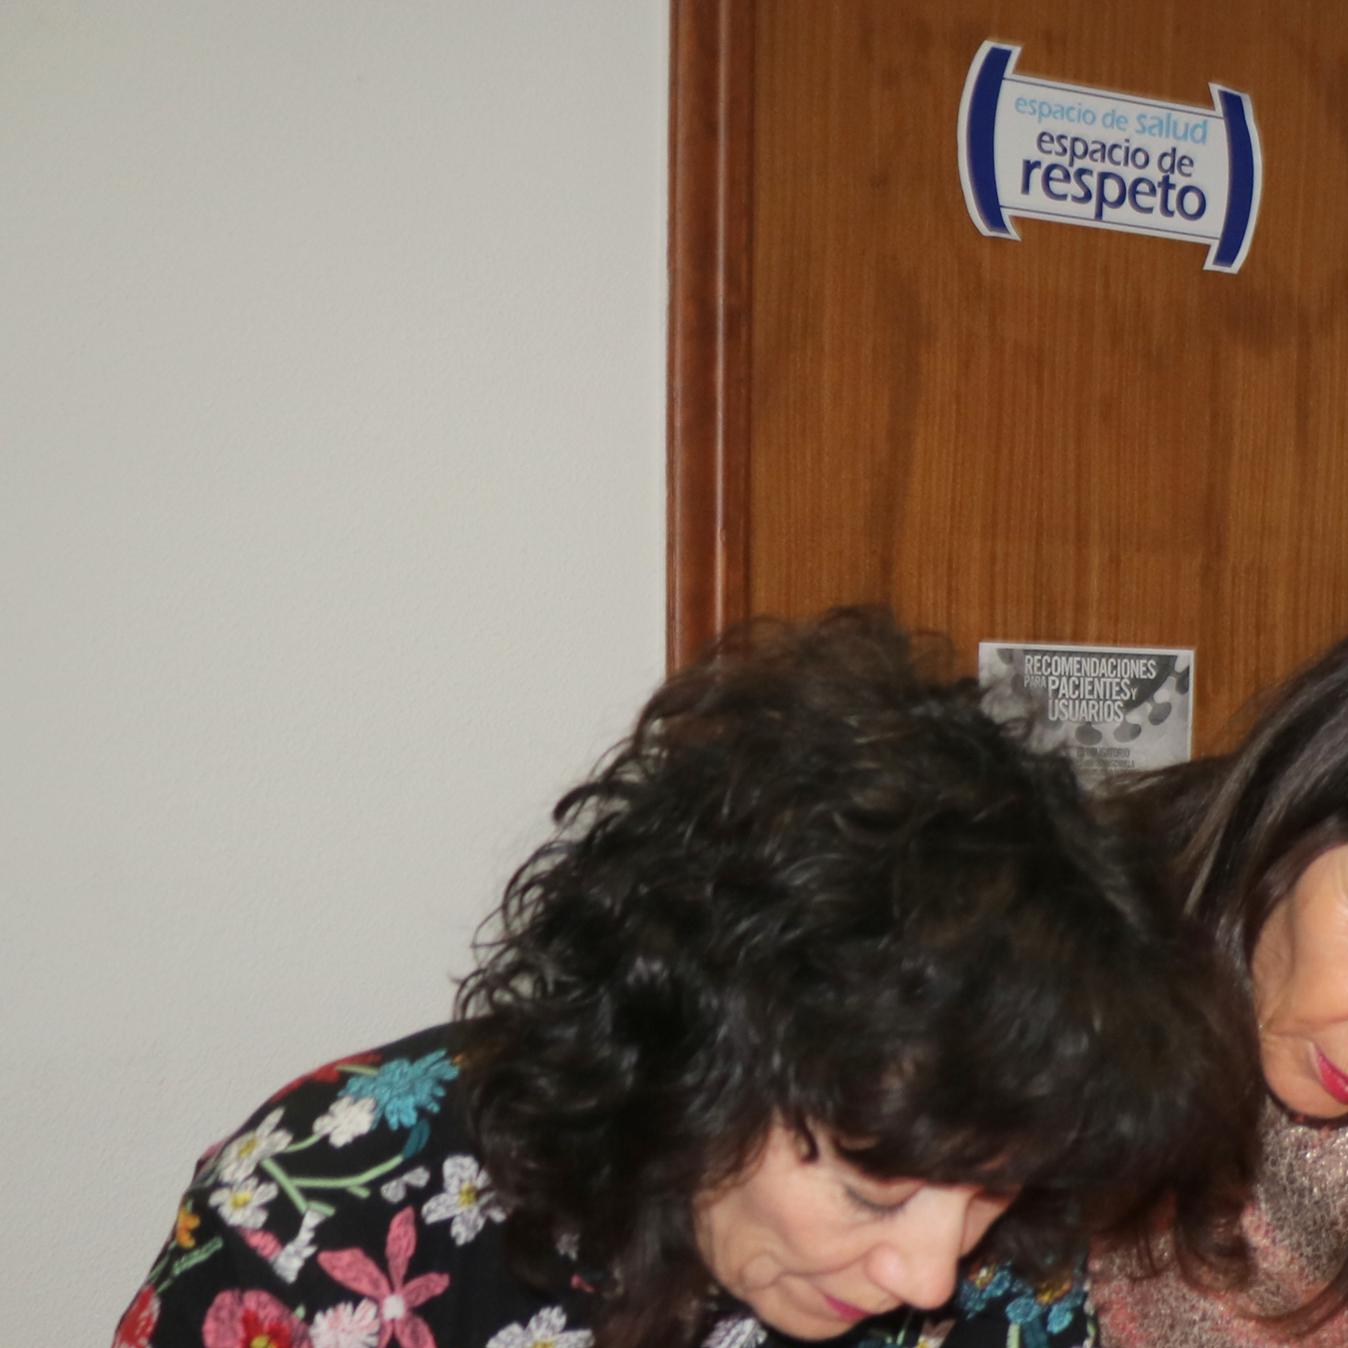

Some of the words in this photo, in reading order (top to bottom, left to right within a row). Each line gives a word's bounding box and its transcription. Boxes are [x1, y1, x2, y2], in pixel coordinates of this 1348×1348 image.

[1015, 95, 1096, 125] espacio
[1101, 108, 1128, 131] de
[1136, 112, 1209, 144] salud
[1036, 130, 1150, 170] espacio
[1157, 147, 1194, 177] de
[1021, 158, 1207, 222] respeto
[1024, 655, 1157, 679] RECOMENDACIONES
[1023, 676, 1047, 688] PARA
[1048, 677, 1130, 700] PACIENTES
[1130, 687, 1138, 700] Y
[1048, 700, 1125, 722] USUARIOS
